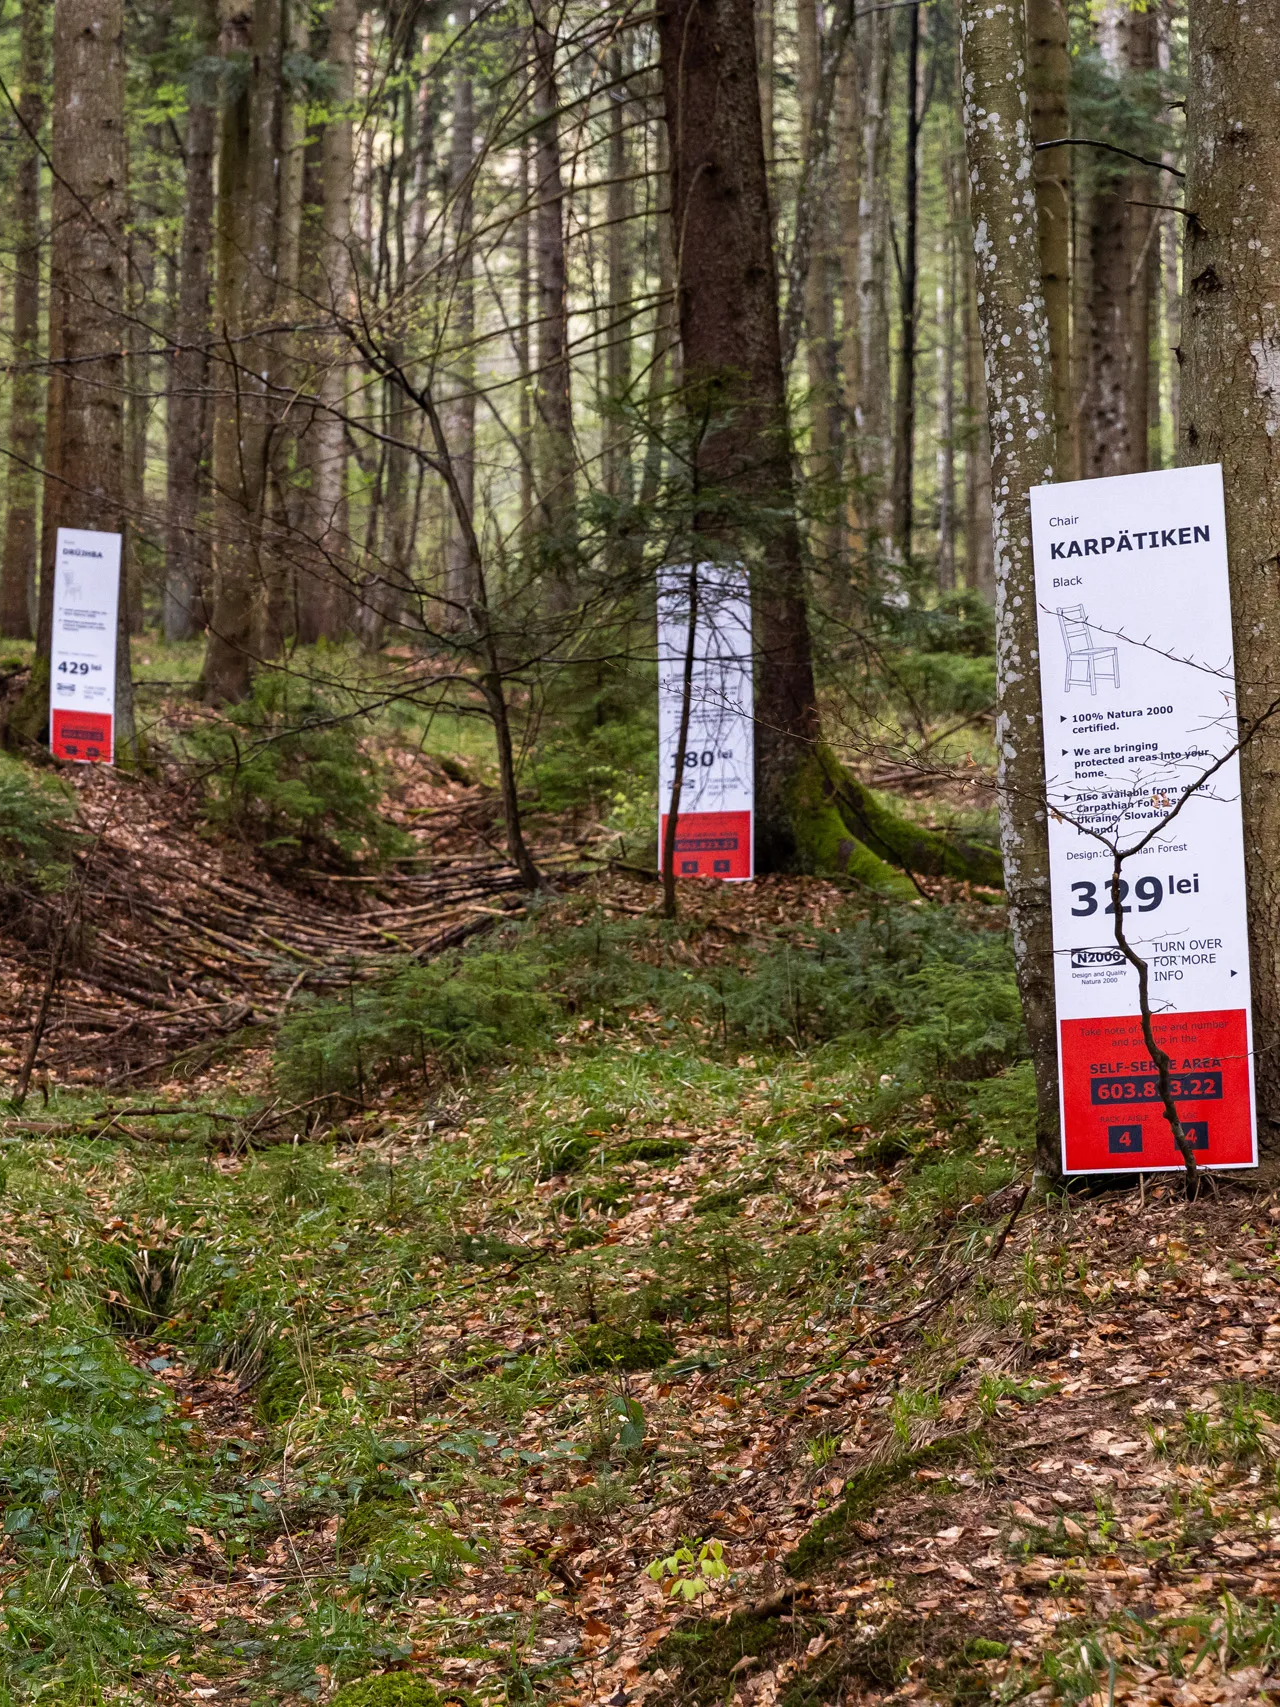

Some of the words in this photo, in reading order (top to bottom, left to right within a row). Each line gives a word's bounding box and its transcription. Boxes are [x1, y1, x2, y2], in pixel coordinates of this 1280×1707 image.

[1049, 516, 1079, 527] Chair
[1051, 525, 1210, 560] KARPÄTIKEN
[1053, 576, 1082, 587] Black
[1072, 713, 1103, 723] 100%
[1107, 709, 1143, 719] Natura
[1147, 705, 1173, 715] 2000
[1072, 723, 1120, 734] certified.
[1074, 748, 1091, 756] We
[1094, 747, 1111, 755] are
[1114, 742, 1158, 754] bringing
[1075, 755, 1124, 769] protected
[1128, 754, 1157, 764] areas
[1161, 751, 1181, 760] into
[1185, 749, 1209, 759] your
[1075, 770, 1107, 779] home.
[1076, 793, 1098, 802] Also
[1101, 788, 1149, 799] available
[1153, 785, 1177, 795] from
[1077, 799, 1134, 813] Carpathian
[1158, 843, 1187, 853] Forest
[1152, 941, 1184, 953] TURN
[1189, 939, 1222, 950] OVER
[1154, 955, 1177, 967] FOR
[1182, 954, 1216, 965] MORE
[1107, 970, 1126, 978] Quality
[1155, 970, 1183, 981] INFO
[1090, 1060, 1177, 1074] SELF-SERE
[1182, 1057, 1222, 1069] AREA
[1098, 1079, 1216, 1099] 603.83.22
[1119, 1132, 1131, 1146] 4
[1185, 1128, 1197, 1144] 4
